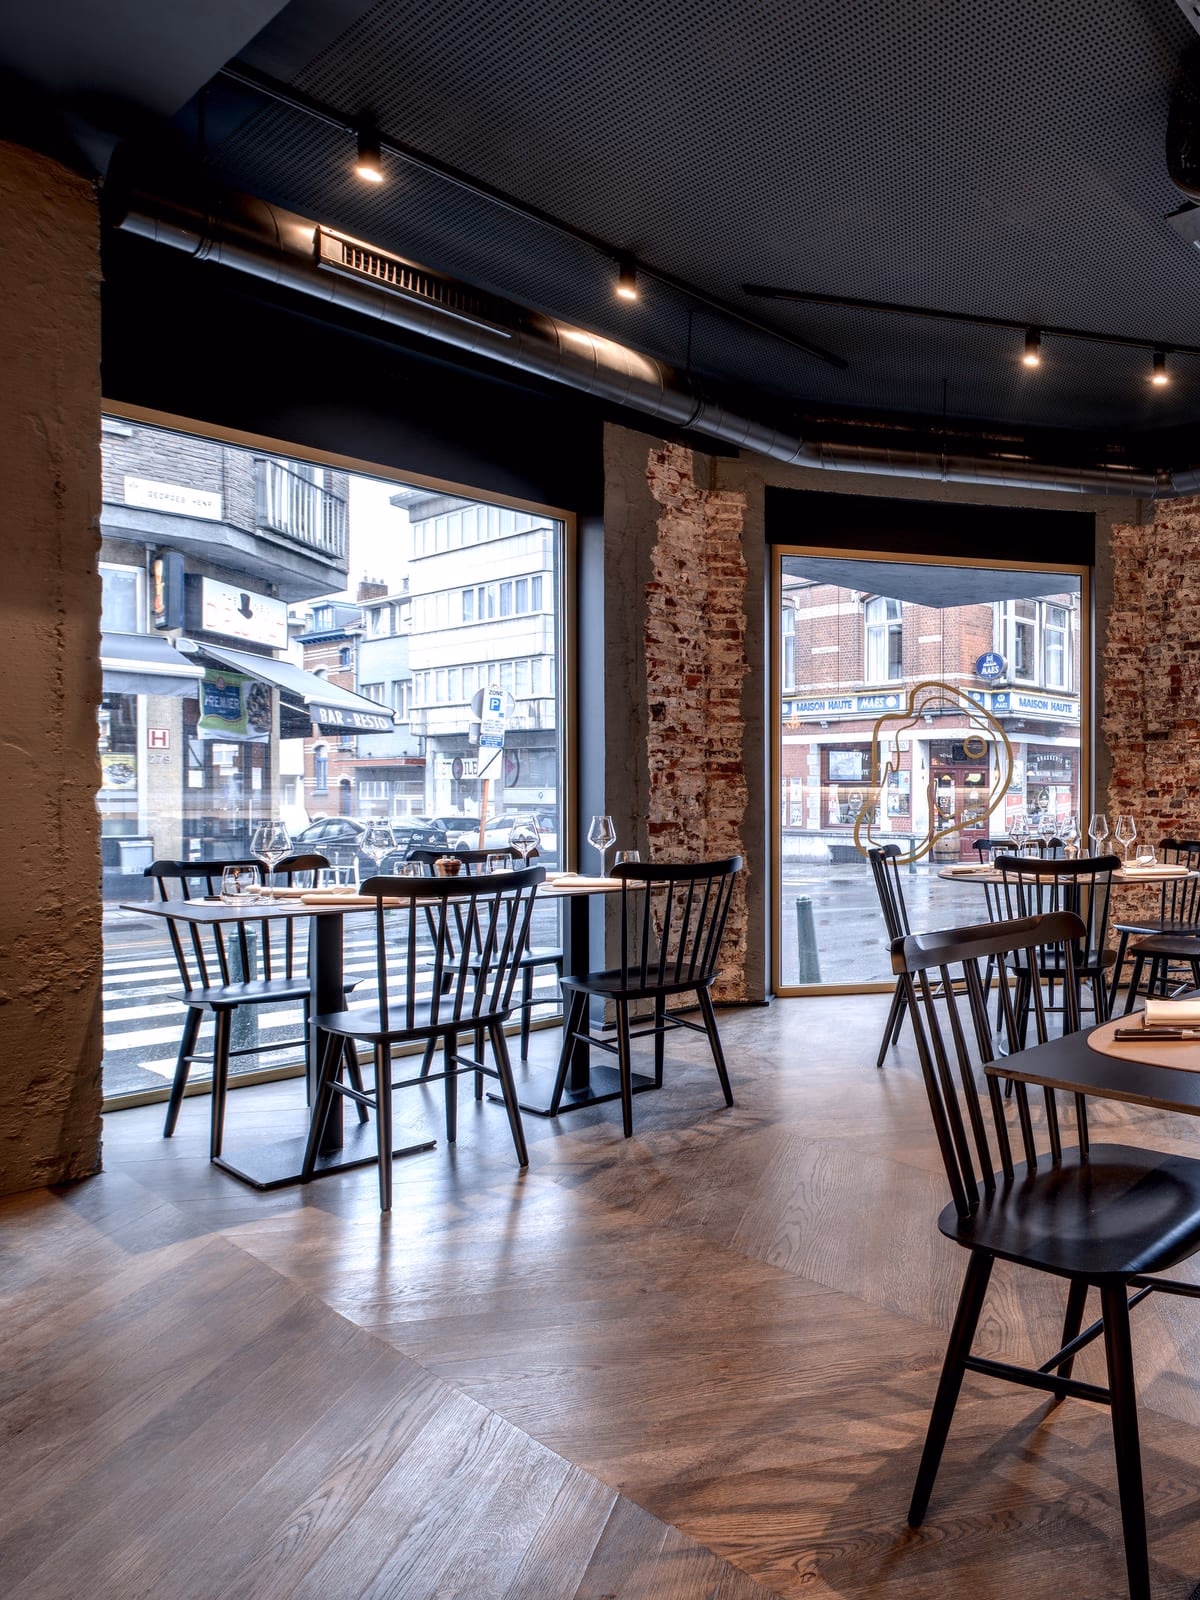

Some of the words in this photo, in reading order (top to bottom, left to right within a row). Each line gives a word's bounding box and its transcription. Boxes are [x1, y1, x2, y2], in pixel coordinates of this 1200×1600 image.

[981, 665, 999, 675] MAES
[796, 701, 826, 713] MAISON
[828, 700, 853, 710] HAUTE
[860, 696, 885, 709] MAES
[1018, 697, 1049, 711] MAISON
[1050, 702, 1073, 713] HAUTE
[319, 708, 345, 725] BAR
[353, 713, 389, 729] RESTO
